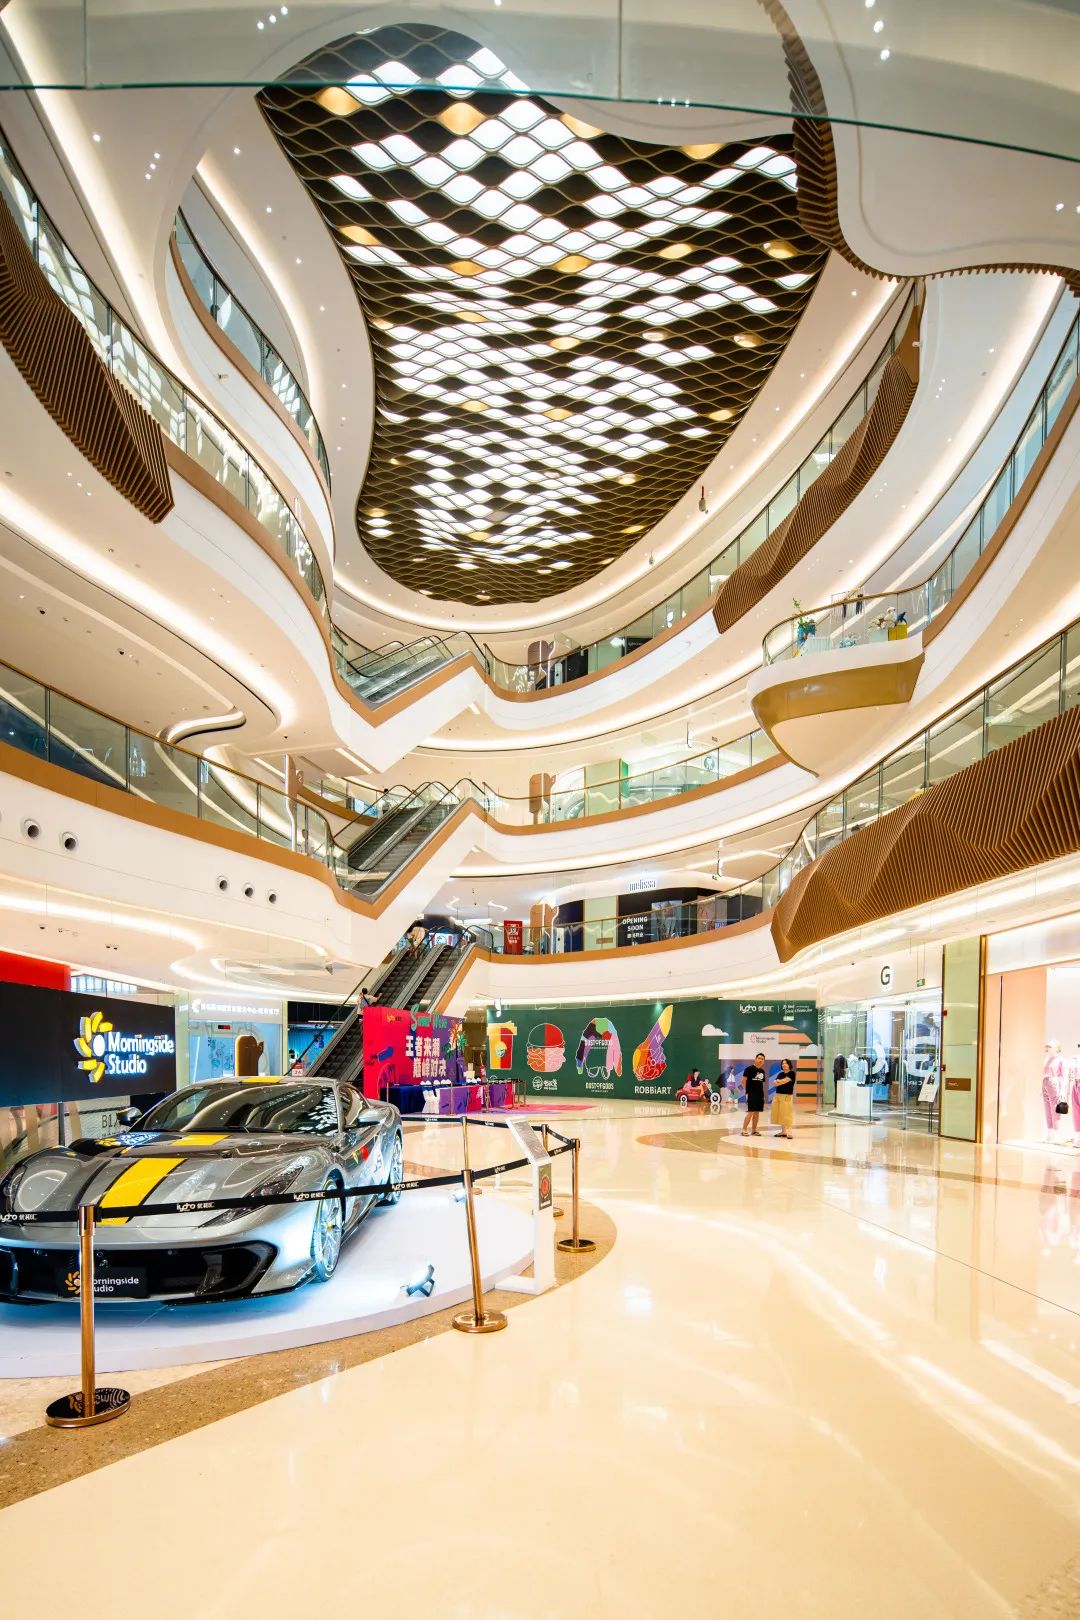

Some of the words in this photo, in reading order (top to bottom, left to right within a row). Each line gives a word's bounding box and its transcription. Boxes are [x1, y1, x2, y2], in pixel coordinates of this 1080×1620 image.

[629, 879, 656, 891] melissa
[622, 916, 648, 925] OPENING
[627, 924, 644, 932] SOON
[880, 965, 891, 986] G
[107, 1031, 175, 1056] Morningside
[107, 1053, 147, 1074] Studio
[93, 1276, 139, 1286] orningside
[93, 1285, 114, 1293] udio
